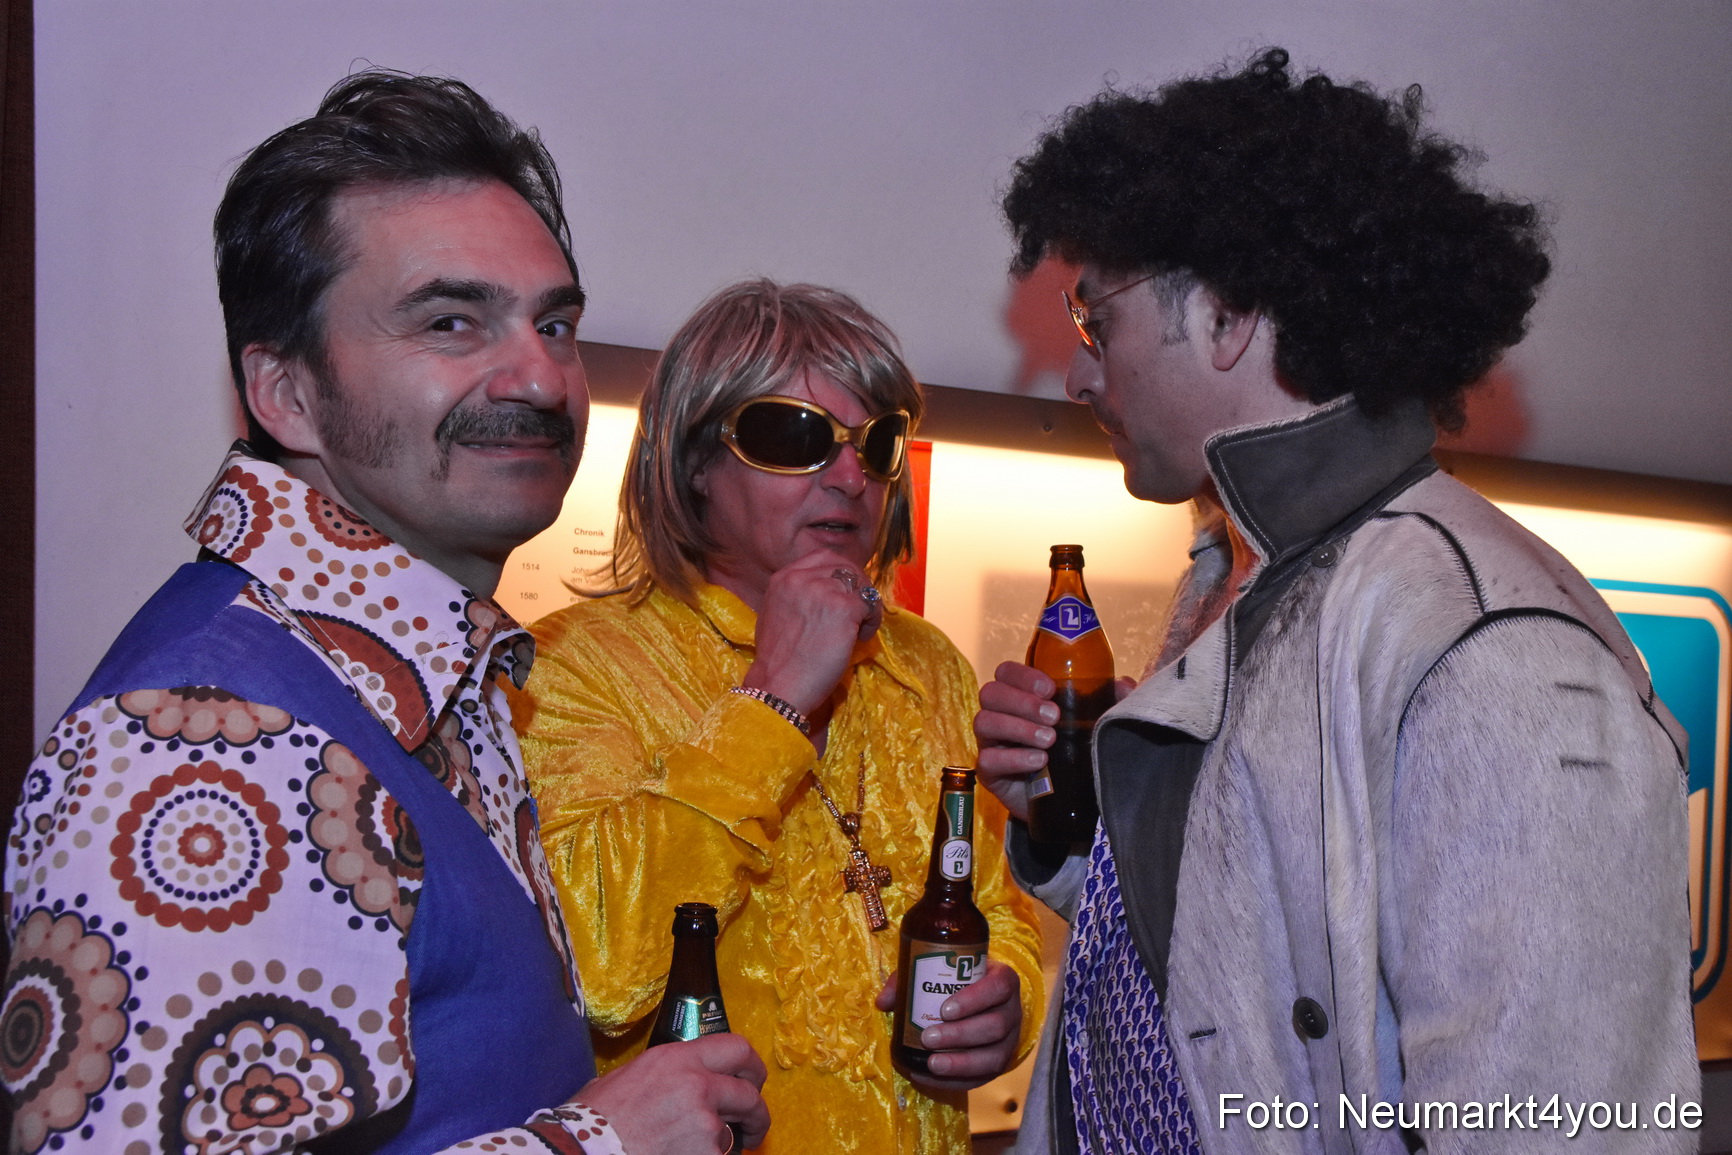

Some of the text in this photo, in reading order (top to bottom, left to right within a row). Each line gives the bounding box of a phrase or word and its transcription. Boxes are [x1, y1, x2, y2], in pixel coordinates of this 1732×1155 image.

[574, 528, 604, 537] Chronik
[522, 563, 540, 571] 1514
[520, 592, 538, 601] 1580
[945, 845, 970, 859] Pils
[922, 981, 971, 995] GANS
